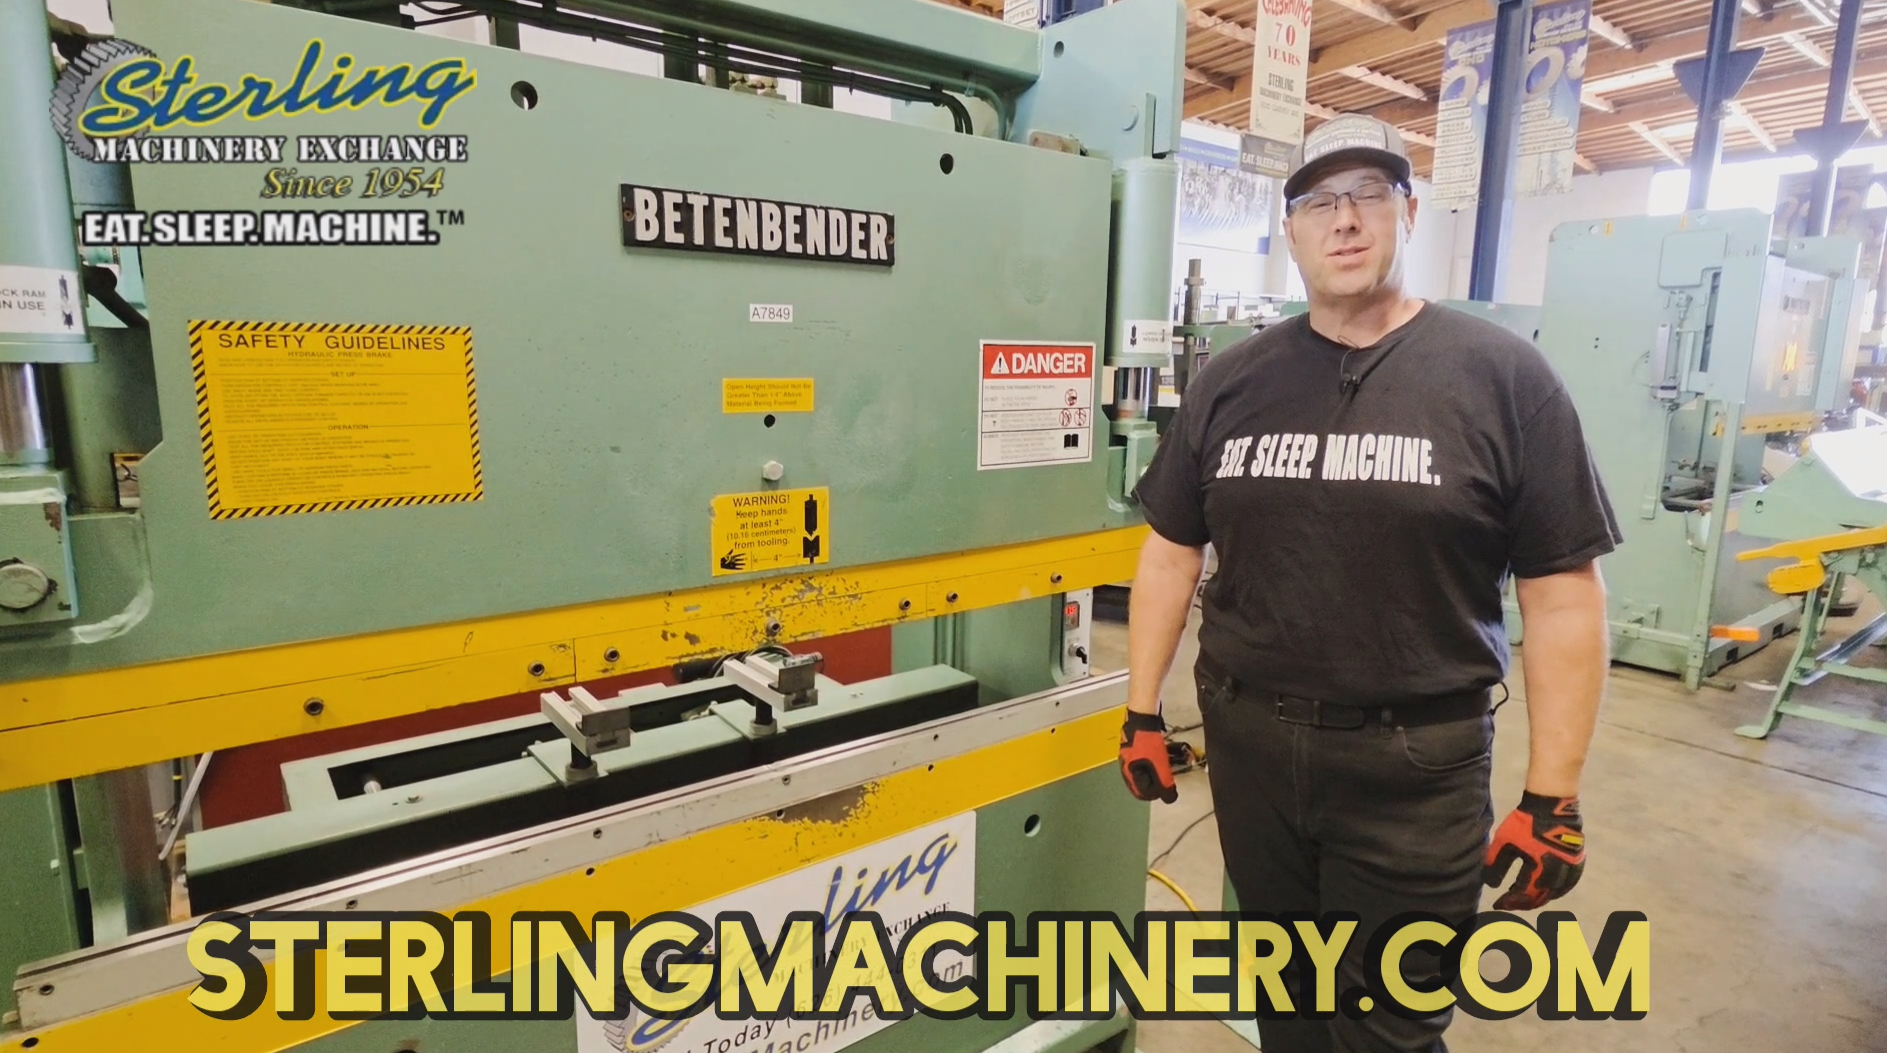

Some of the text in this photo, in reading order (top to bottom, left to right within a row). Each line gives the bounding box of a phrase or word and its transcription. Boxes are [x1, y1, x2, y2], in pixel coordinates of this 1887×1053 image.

[1267, 45, 1301, 67] YEARS
[1267, 72, 1295, 92] STERLING
[633, 188, 889, 260] BETENBENDER
[0, 288, 46, 298] CK RAM
[17, 300, 45, 311] USE
[751, 306, 791, 321] A7849
[218, 333, 446, 351] SAFETY GUIDELINES
[287, 350, 335, 358] HYDRAULIC
[366, 351, 393, 359] BRAKE
[1011, 352, 1087, 375] DANGER
[1321, 433, 1441, 486] MACHINE.
[732, 494, 790, 508] WARNING!
[736, 507, 788, 520] Keep hands
[740, 521, 749, 530] at
[751, 519, 772, 529] least
[750, 526, 797, 538] centimeters)
[734, 540, 755, 550] from
